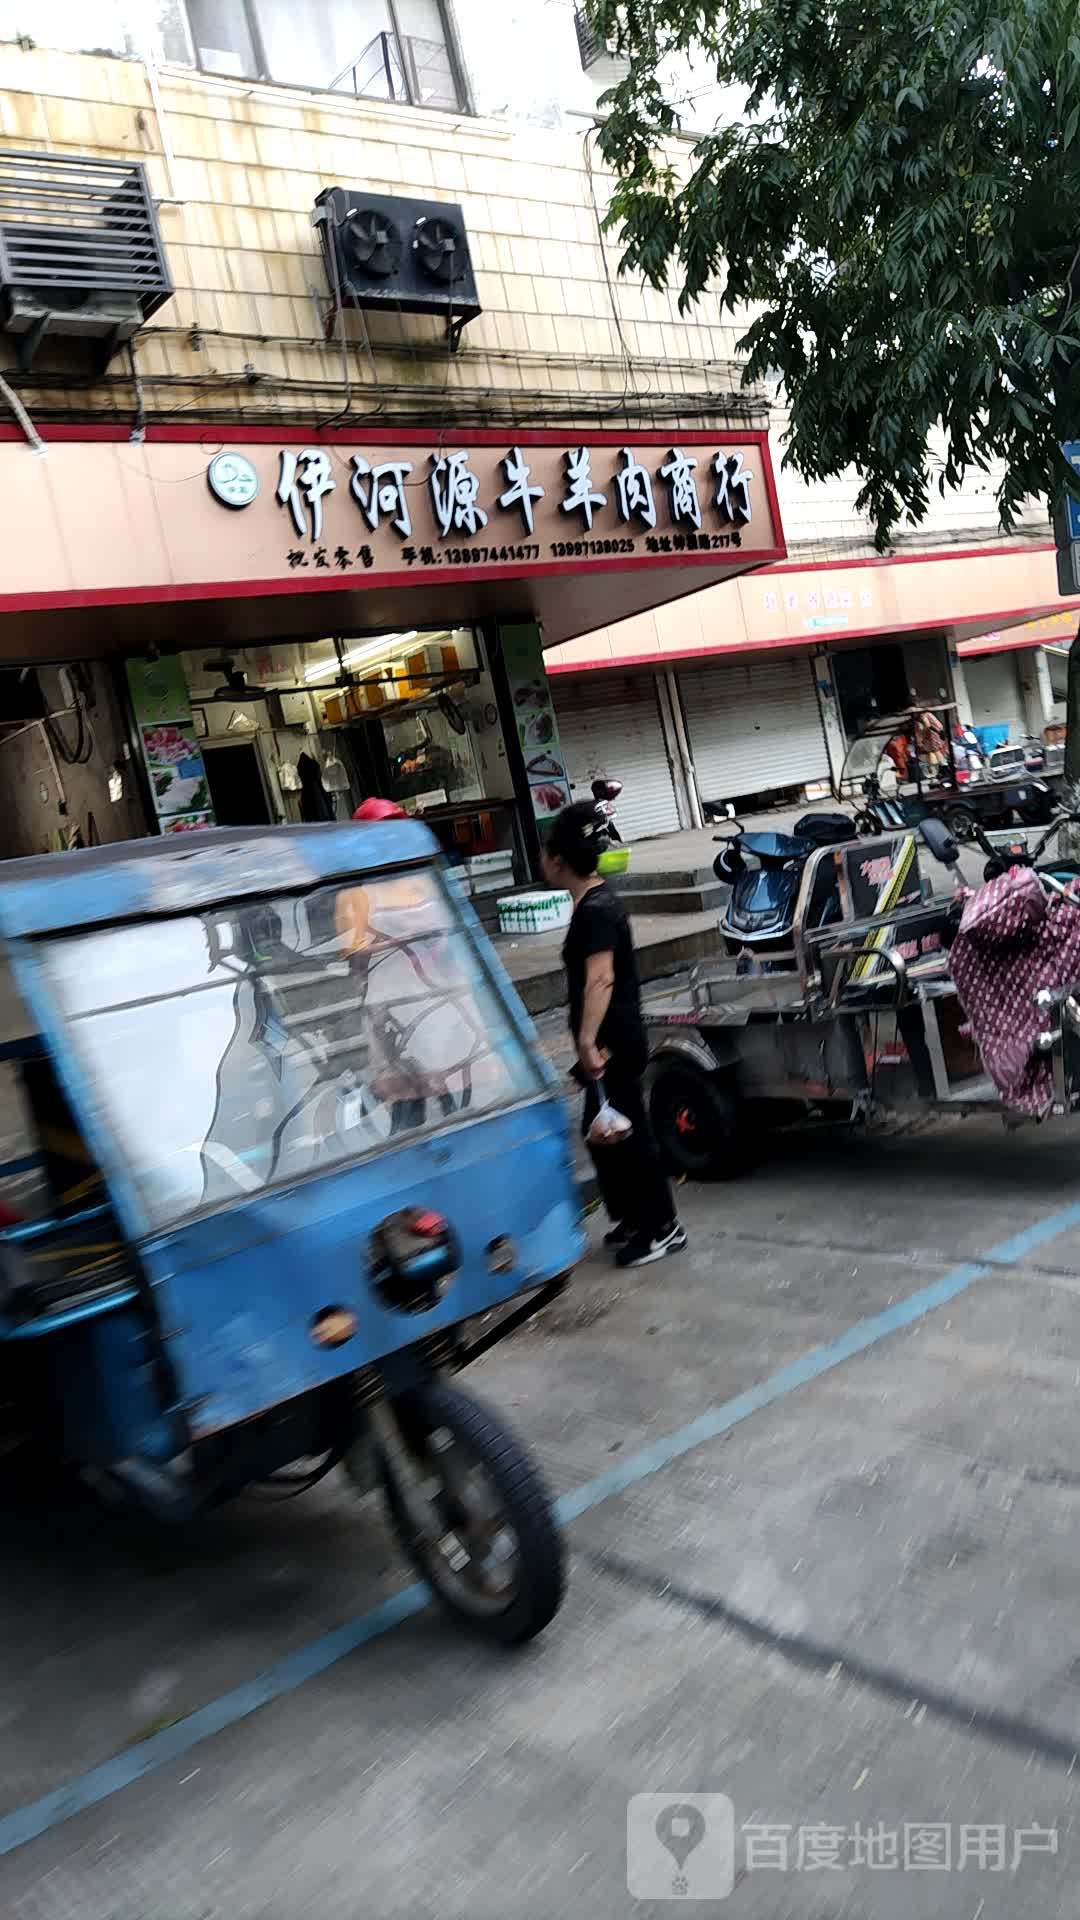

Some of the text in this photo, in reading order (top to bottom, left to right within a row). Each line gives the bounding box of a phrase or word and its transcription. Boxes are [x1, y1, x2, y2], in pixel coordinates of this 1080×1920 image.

[277, 446, 754, 540] 伊河源牛羊肉商行
[287, 545, 374, 570] 批发零售
